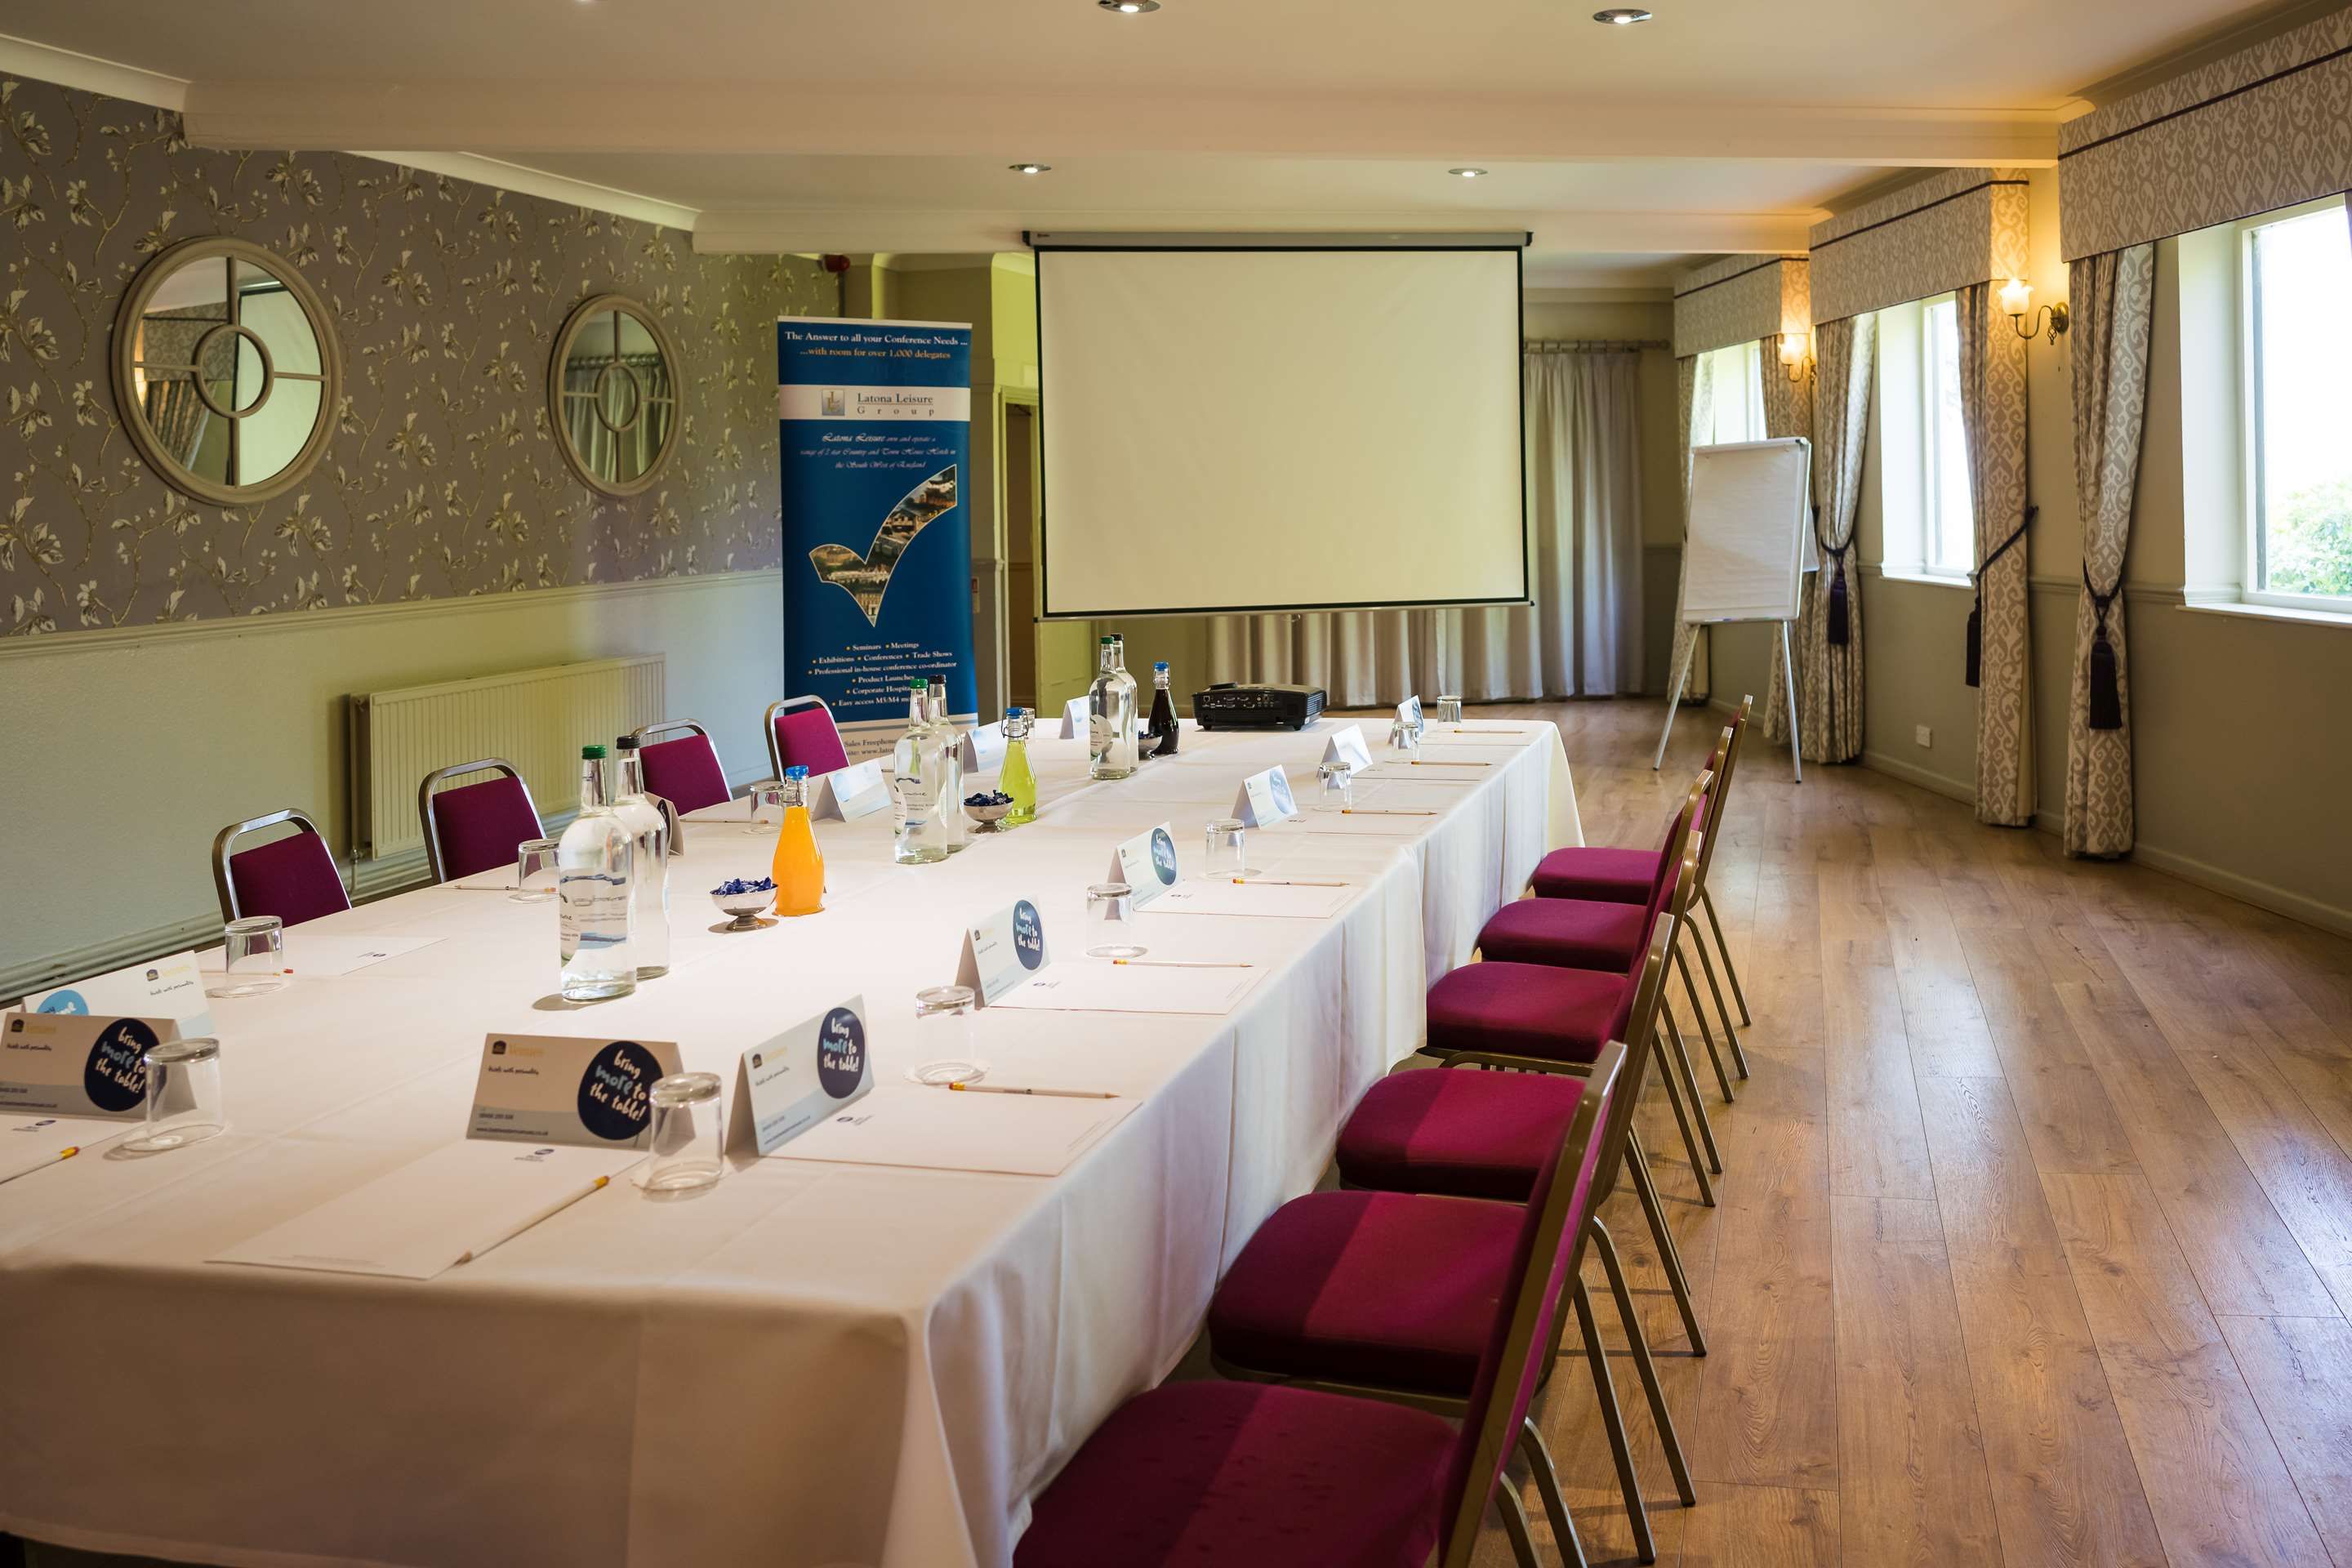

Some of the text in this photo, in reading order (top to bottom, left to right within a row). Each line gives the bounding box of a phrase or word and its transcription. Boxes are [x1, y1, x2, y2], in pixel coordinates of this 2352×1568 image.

[785, 332, 803, 341] The
[805, 332, 838, 341] Answer
[851, 333, 862, 342] all
[863, 336, 882, 344] your
[884, 334, 932, 344] Conference
[933, 336, 959, 345] Needs
[853, 348, 866, 356] for
[915, 350, 951, 359] delegates
[857, 392, 893, 403] Latona
[896, 393, 933, 404] Leisure
[822, 432, 853, 443] Latona
[855, 432, 885, 443] Leisure
[814, 666, 853, 675] Professional
[858, 675, 884, 684] Product
[831, 1017, 849, 1038] bring
[118, 1027, 142, 1055] bring
[822, 1038, 858, 1055] more to
[101, 1040, 146, 1074] more to
[613, 1049, 641, 1080] bring
[823, 1053, 860, 1072] the table!
[96, 1058, 145, 1094] the table!
[595, 1064, 647, 1101] more to
[590, 1083, 648, 1122] the table!
